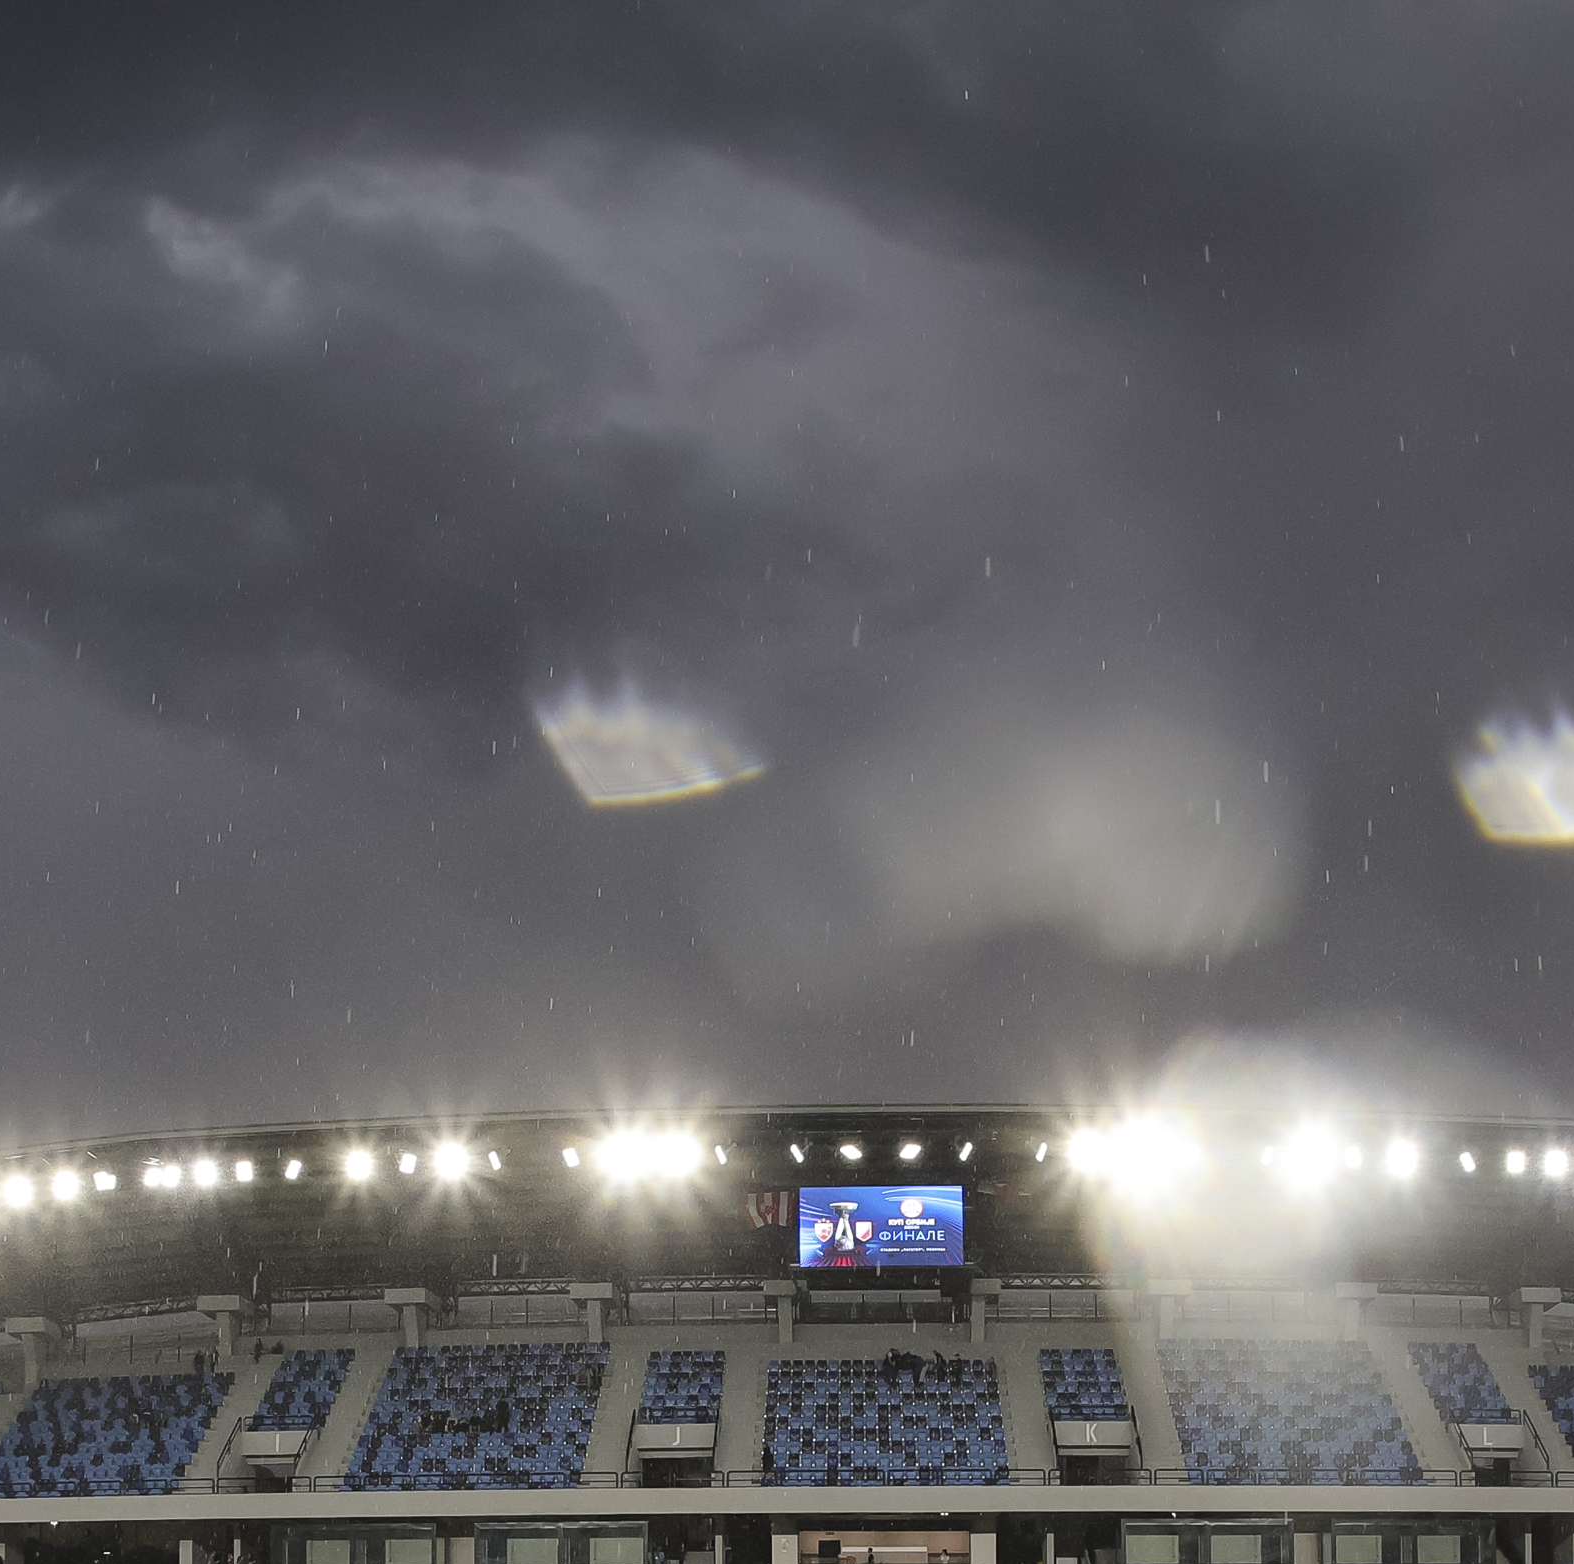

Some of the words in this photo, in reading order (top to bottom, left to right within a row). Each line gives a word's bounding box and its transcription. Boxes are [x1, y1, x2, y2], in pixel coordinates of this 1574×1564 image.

[879, 1230, 945, 1241] ФИНАЛЕ
[672, 1426, 681, 1446] J
[1086, 1423, 1098, 1443] K
[1483, 1426, 1493, 1446] L
